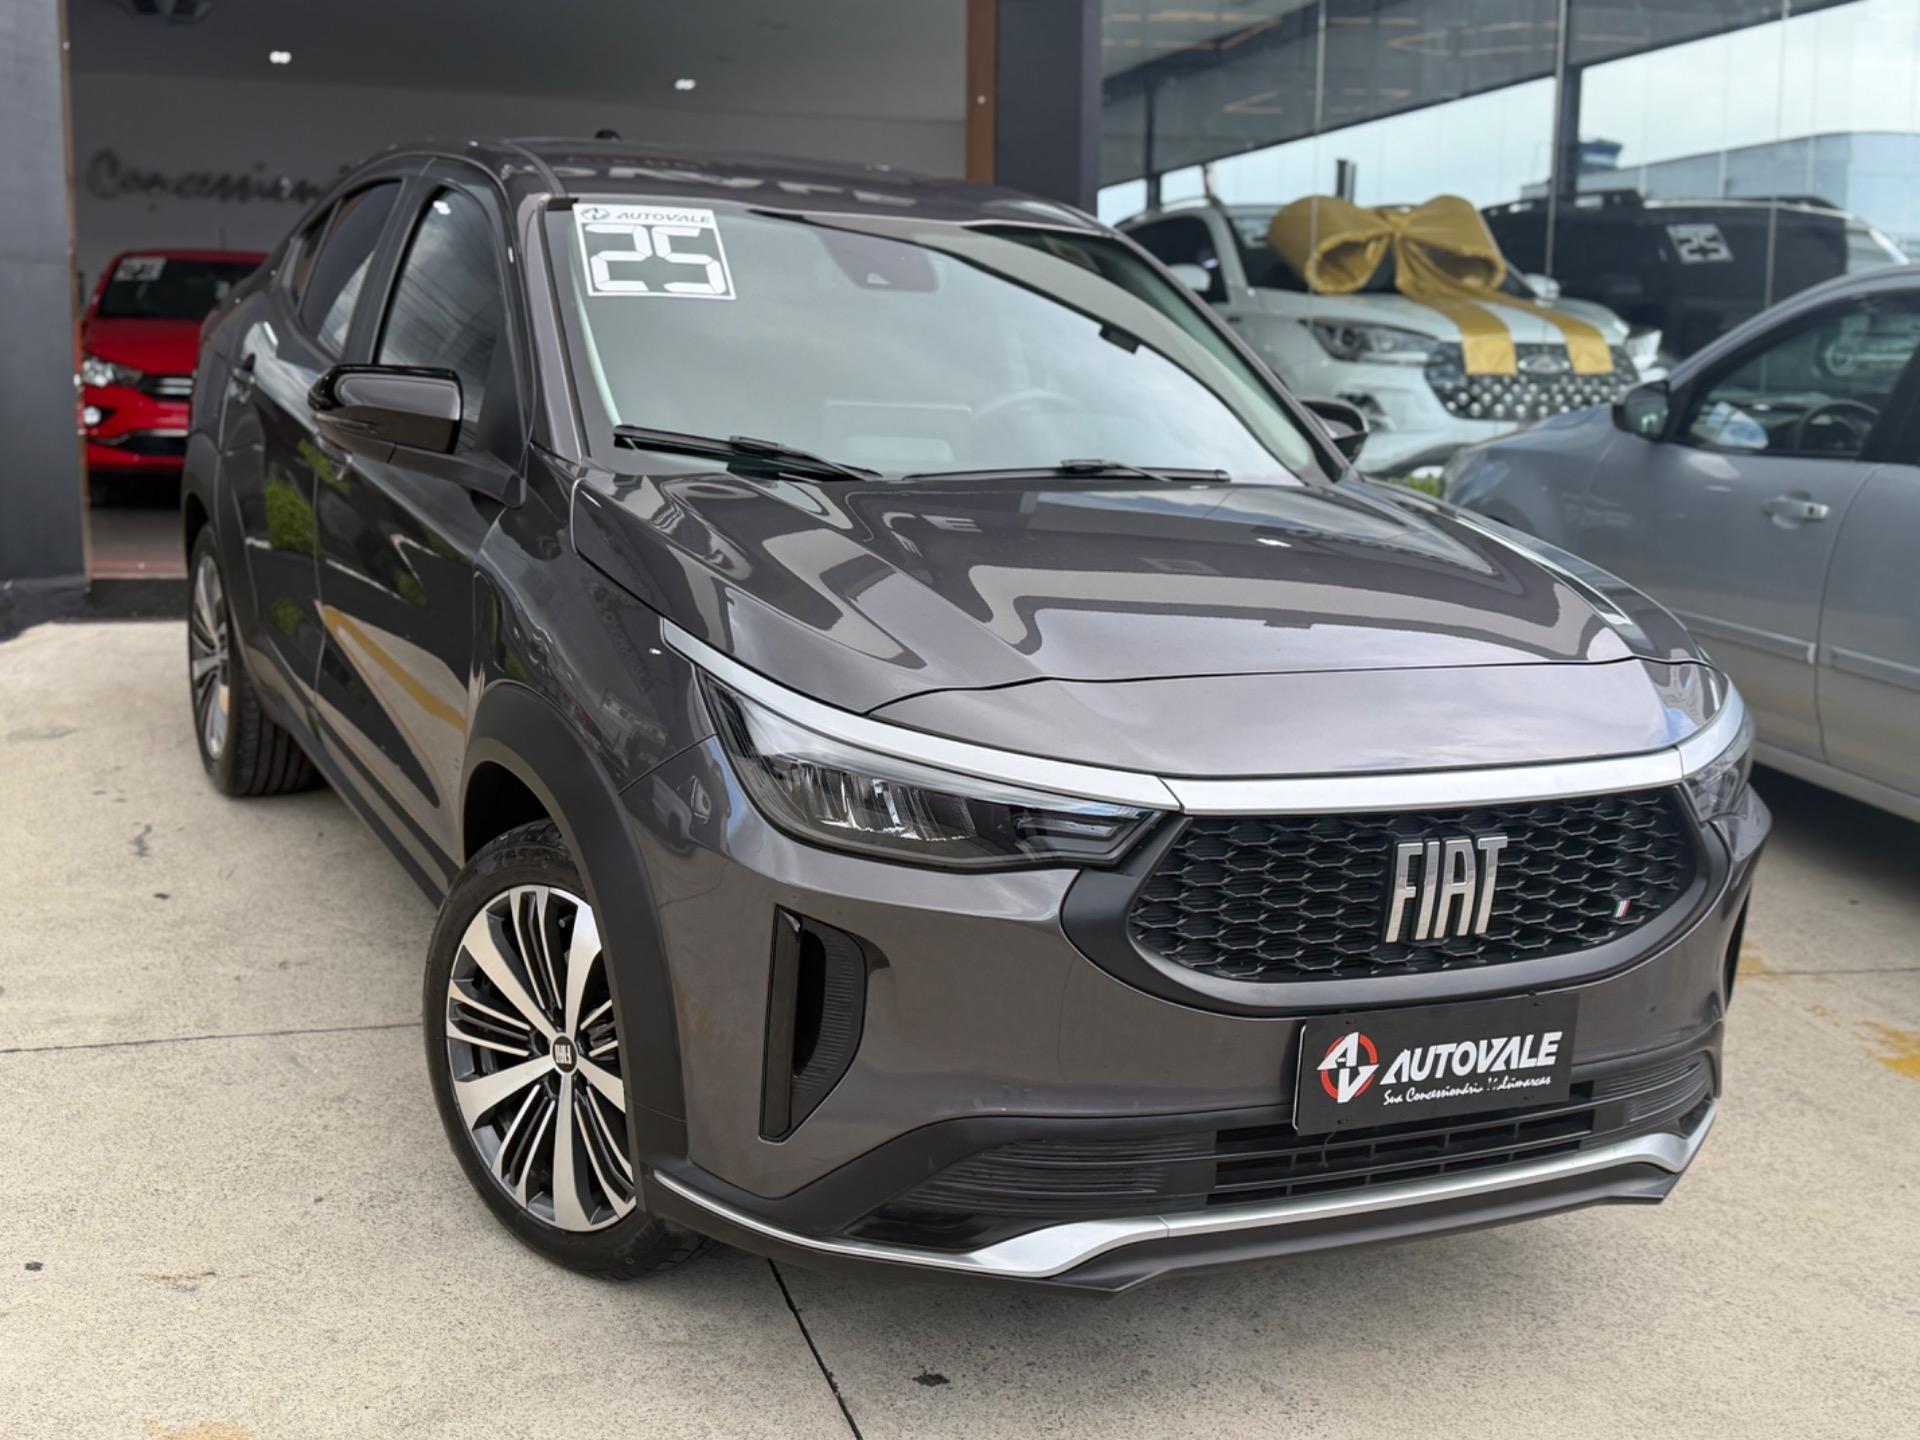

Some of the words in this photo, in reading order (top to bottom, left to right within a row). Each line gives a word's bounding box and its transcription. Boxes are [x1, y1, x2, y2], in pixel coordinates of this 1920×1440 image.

[616, 211, 711, 224] AUTOVALE
[584, 224, 727, 294] 25
[1675, 230, 1731, 262] 25
[1385, 835, 1508, 944] FIAT
[1379, 1031, 1563, 1086] AUTOVALE
[1383, 1089, 1404, 1106] Sua
